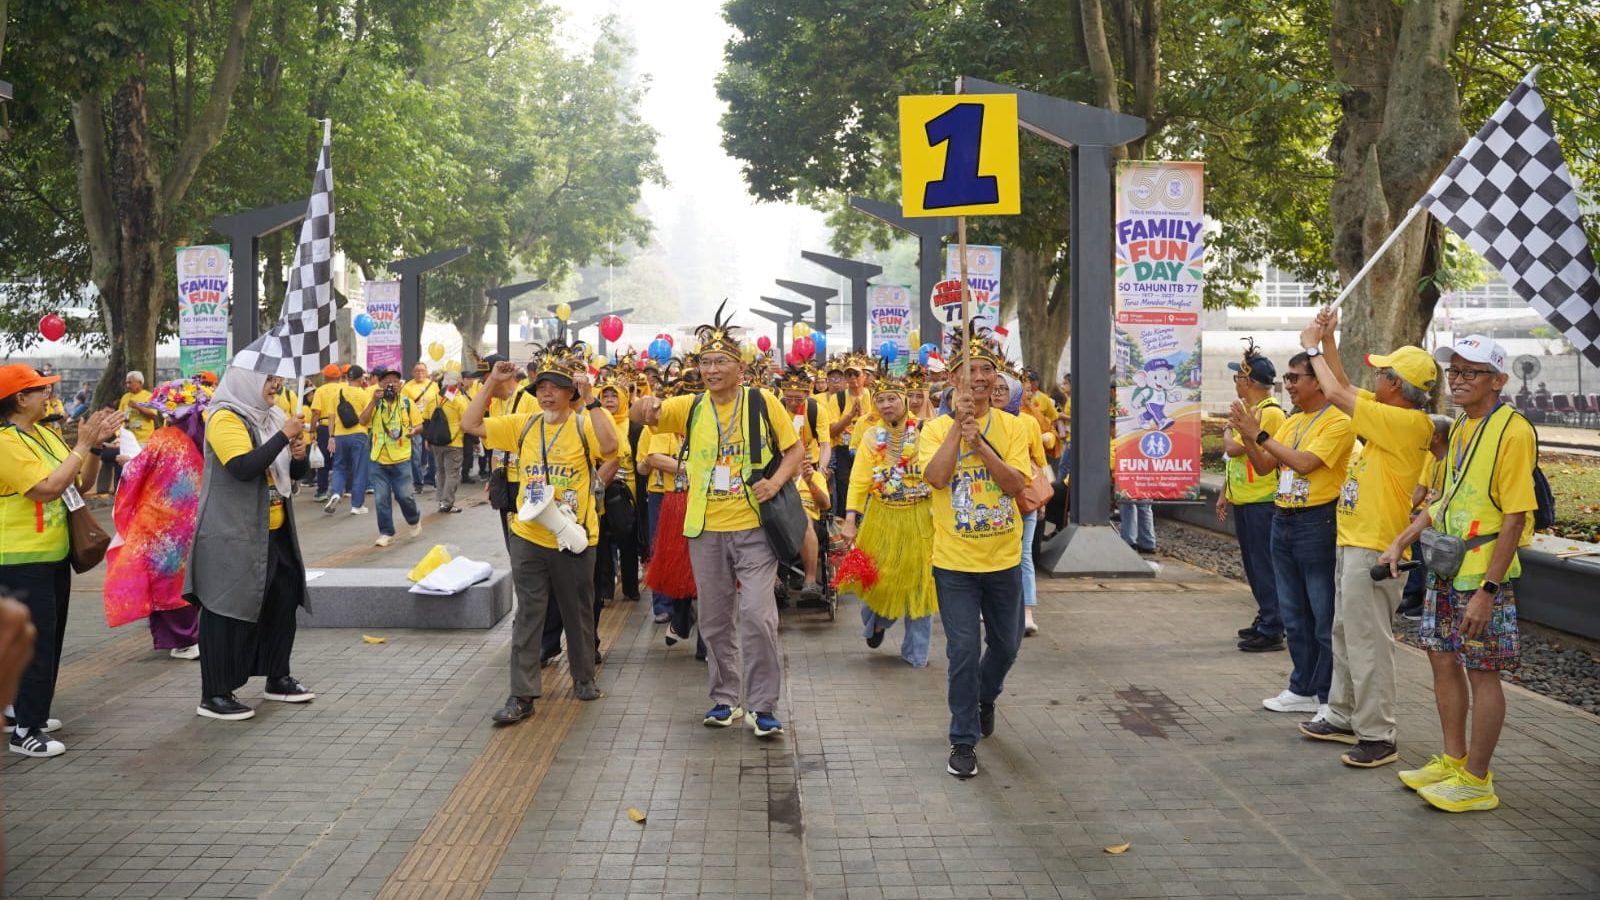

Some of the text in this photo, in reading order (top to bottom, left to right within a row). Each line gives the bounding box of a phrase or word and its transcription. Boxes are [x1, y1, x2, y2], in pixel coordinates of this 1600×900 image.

[923, 103, 999, 210] 1
[1116, 218, 1203, 244] FAMILY
[1128, 240, 1188, 262] FUN
[1134, 261, 1184, 281] DAY
[180, 279, 228, 295] FAMILY
[967, 278, 999, 292] MILY
[1118, 283, 1198, 293] 50 TAHUN ITB 77
[188, 291, 220, 304] FUN
[193, 303, 217, 315] DAY
[872, 308, 909, 319] FAMILY
[879, 316, 903, 325] FUN
[881, 325, 900, 334] DAY
[525, 464, 579, 479] FAMILY
[1119, 458, 1192, 472] FUN WALK
[550, 476, 573, 487] DAY
